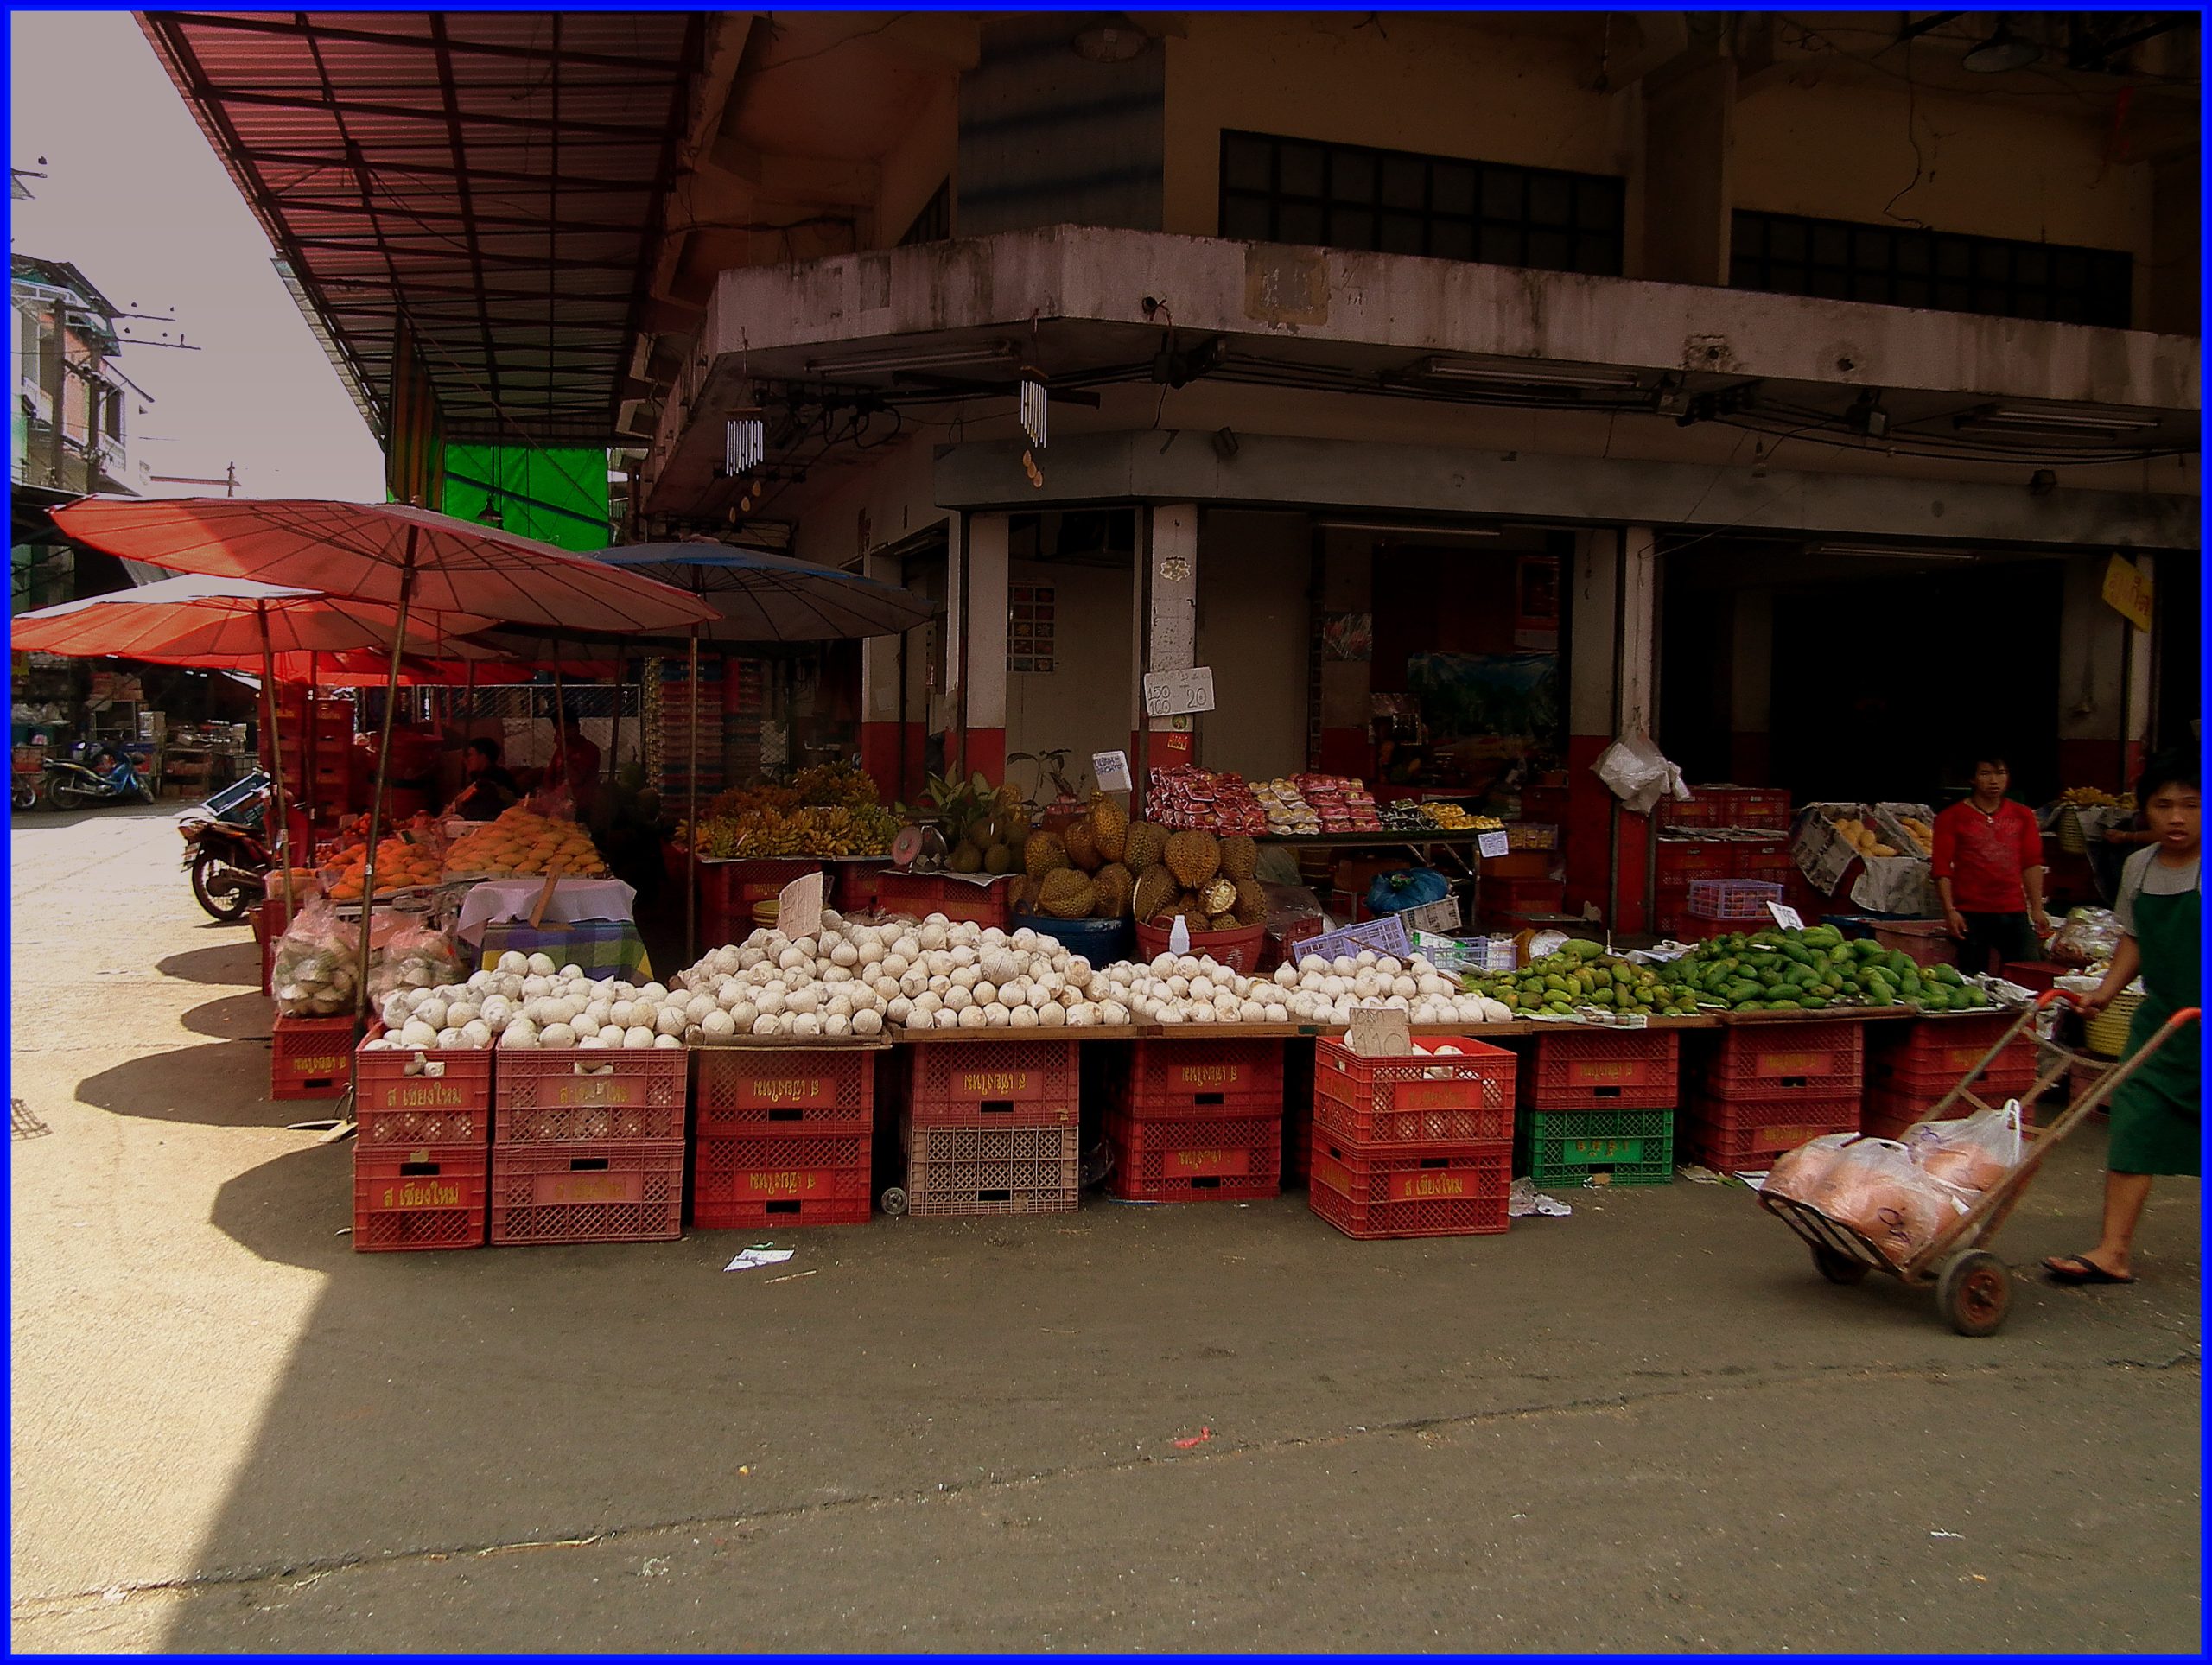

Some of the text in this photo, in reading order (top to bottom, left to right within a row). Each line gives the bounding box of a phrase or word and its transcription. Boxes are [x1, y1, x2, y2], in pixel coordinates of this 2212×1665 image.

[1148, 685, 1207, 709] 150 20
[1357, 1032, 1407, 1056] 110
[1018, 1073, 1027, 1090] ส
[387, 1087, 397, 1107] ส
[383, 1186, 394, 1208] ส
